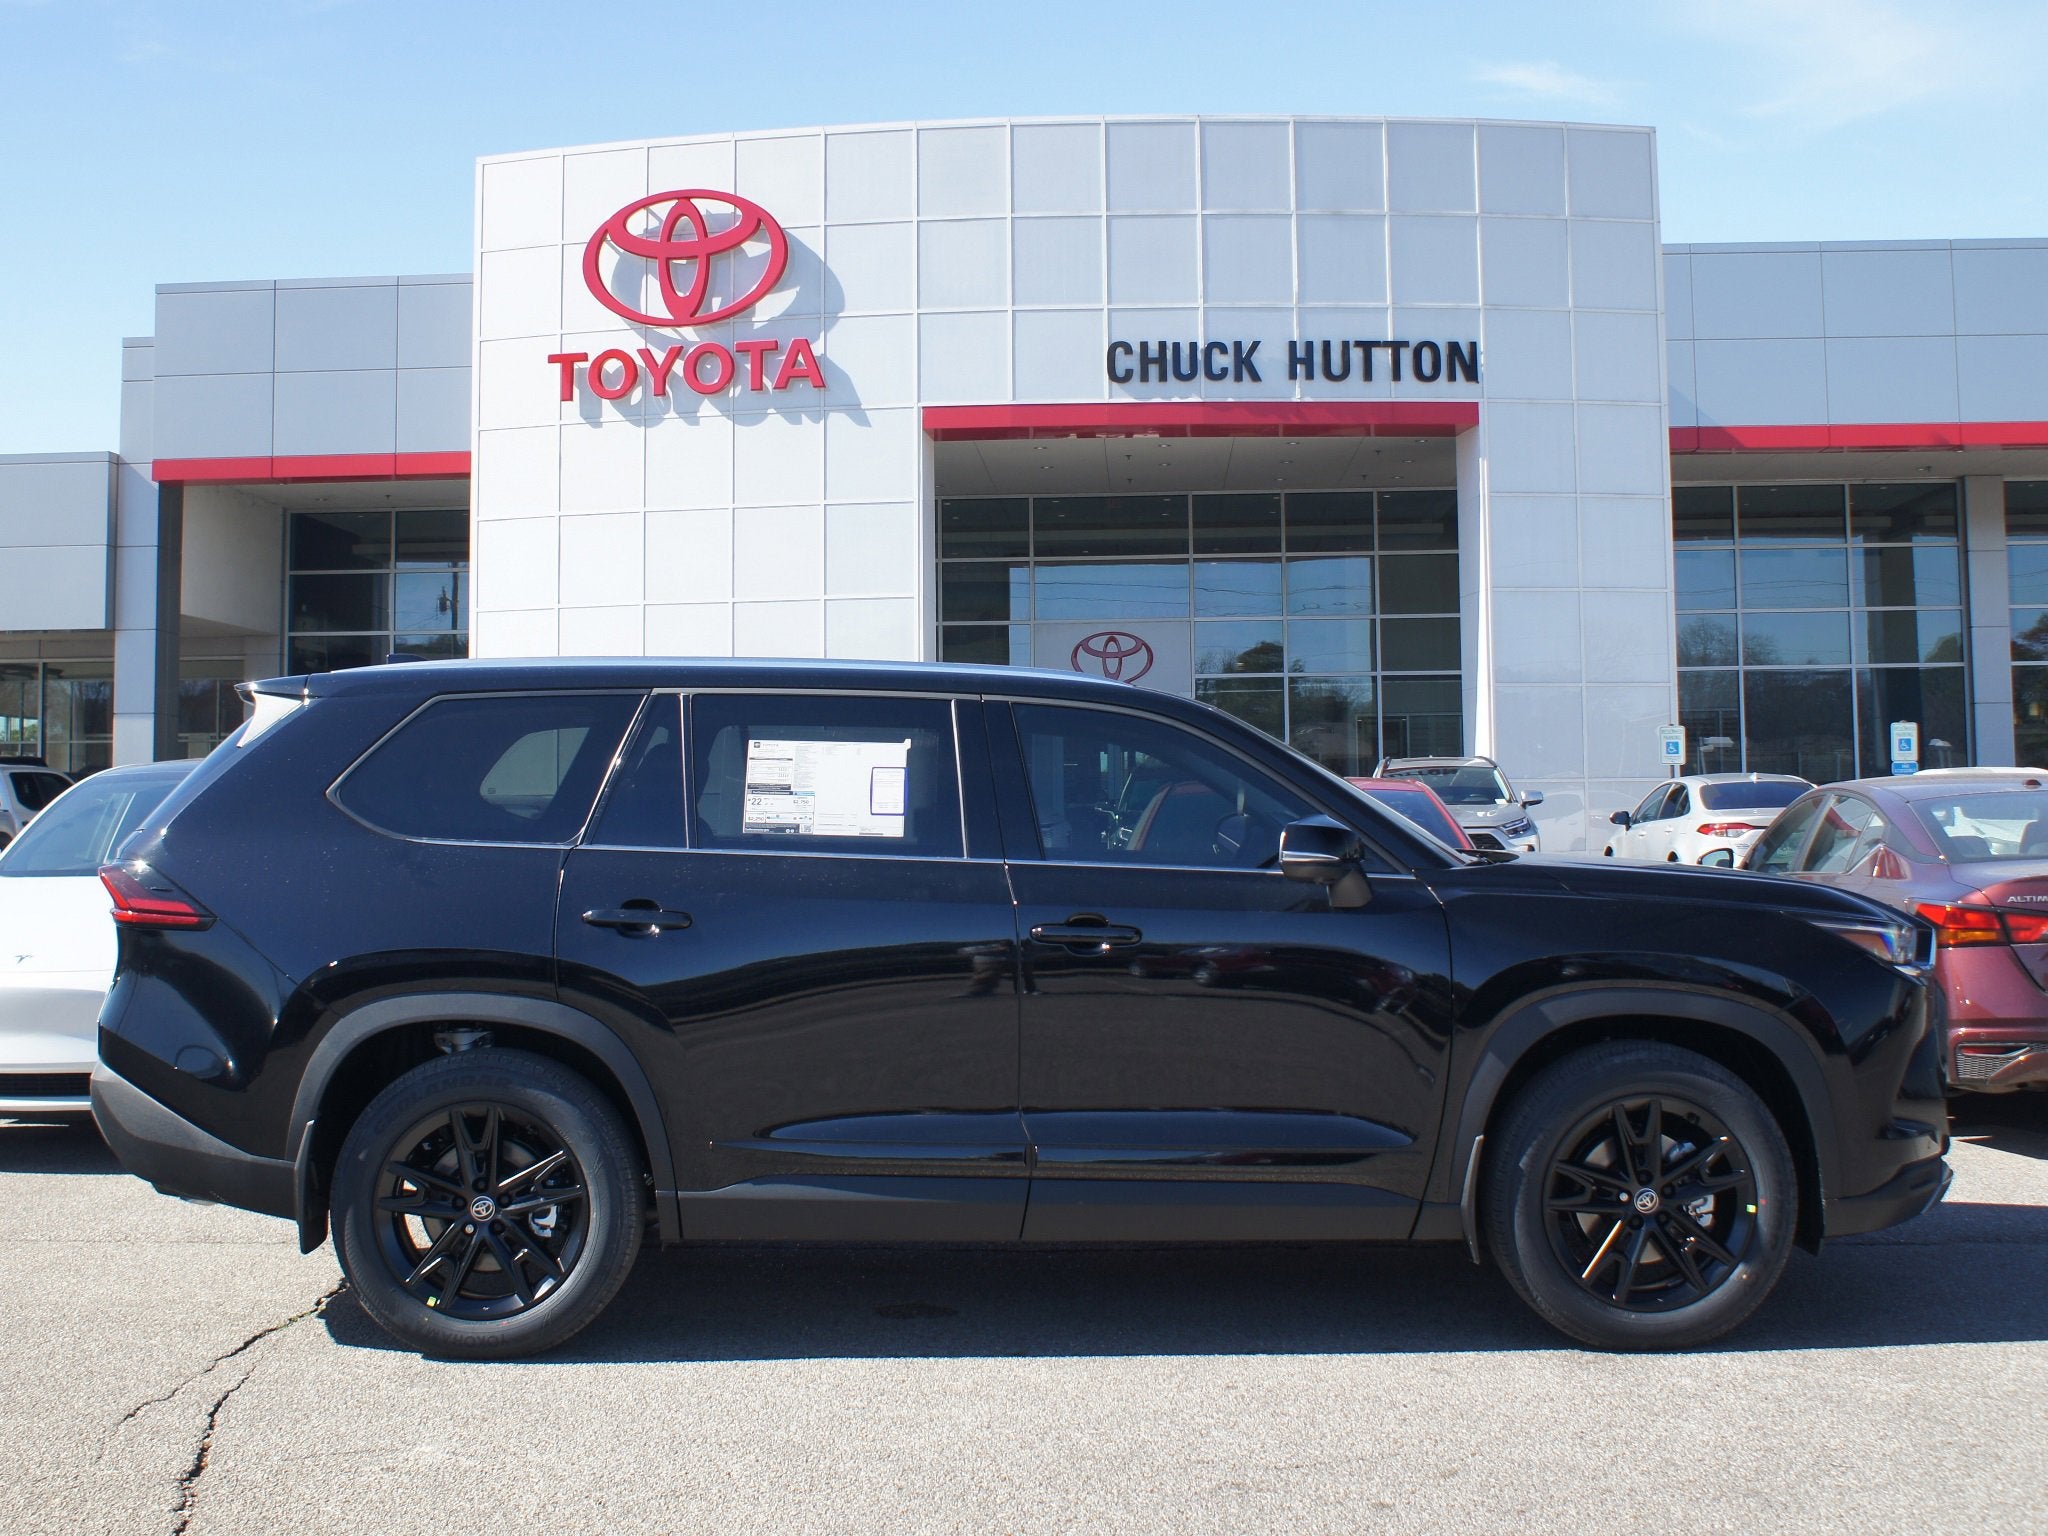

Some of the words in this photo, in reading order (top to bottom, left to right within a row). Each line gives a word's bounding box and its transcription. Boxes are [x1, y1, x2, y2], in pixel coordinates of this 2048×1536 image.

[547, 338, 827, 402] TOYOTA
[1106, 340, 1263, 383] CHUCK
[1288, 340, 1480, 384] HUTTON
